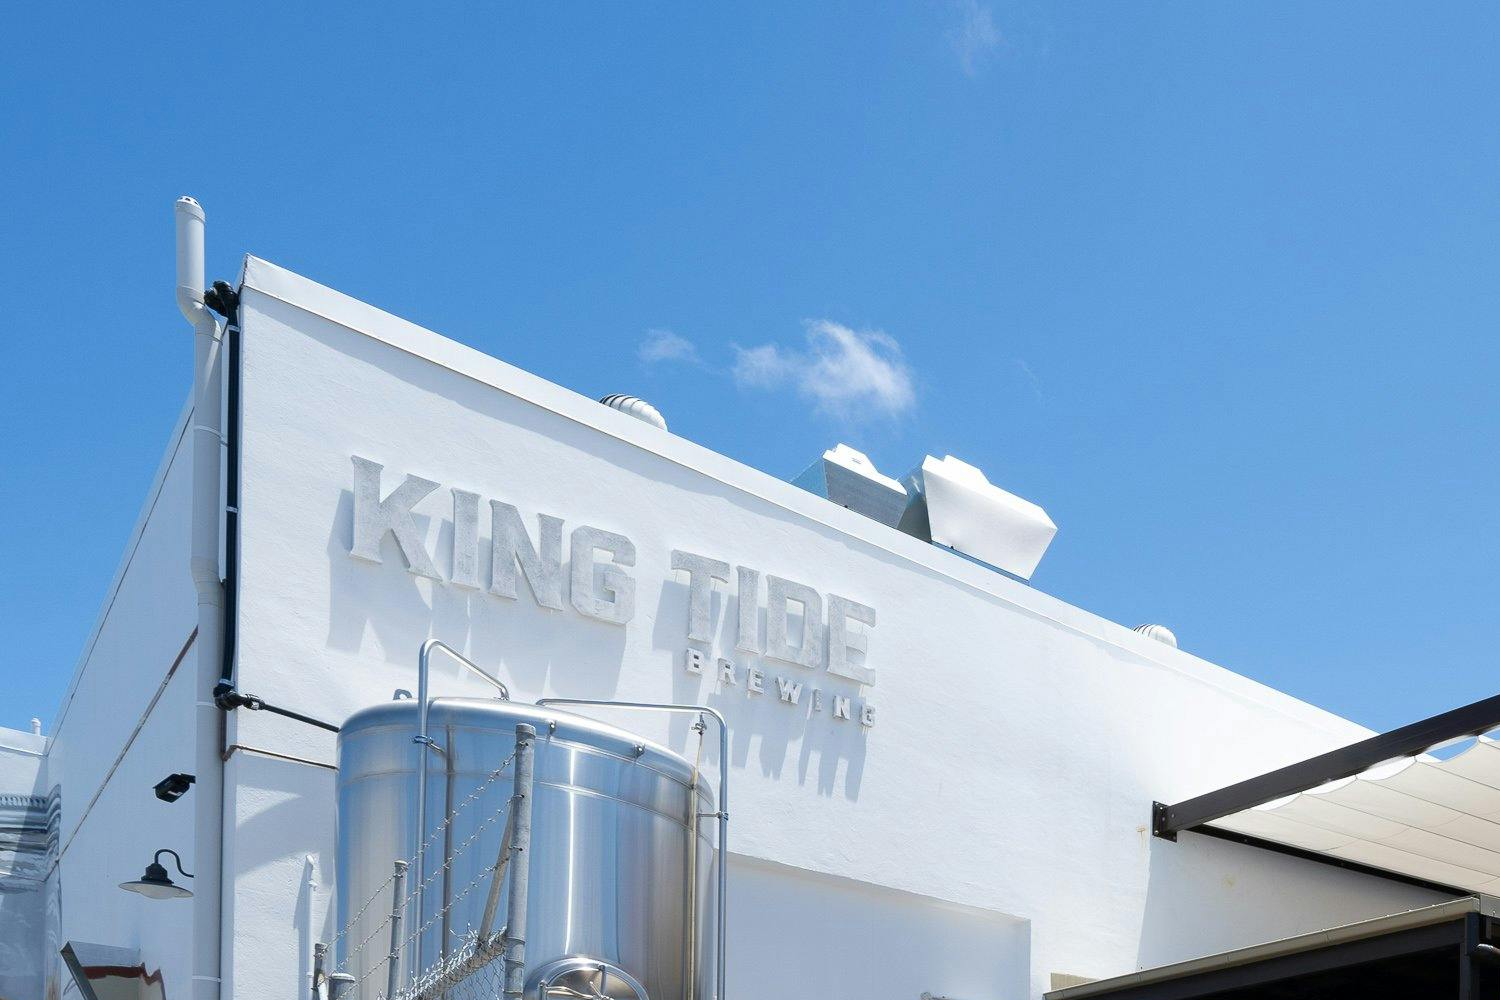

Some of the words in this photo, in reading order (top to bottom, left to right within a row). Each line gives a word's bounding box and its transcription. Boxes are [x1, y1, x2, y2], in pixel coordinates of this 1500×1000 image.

[350, 454, 637, 626] KING
[670, 549, 877, 687] TIDE
[686, 647, 877, 728] BREWING
